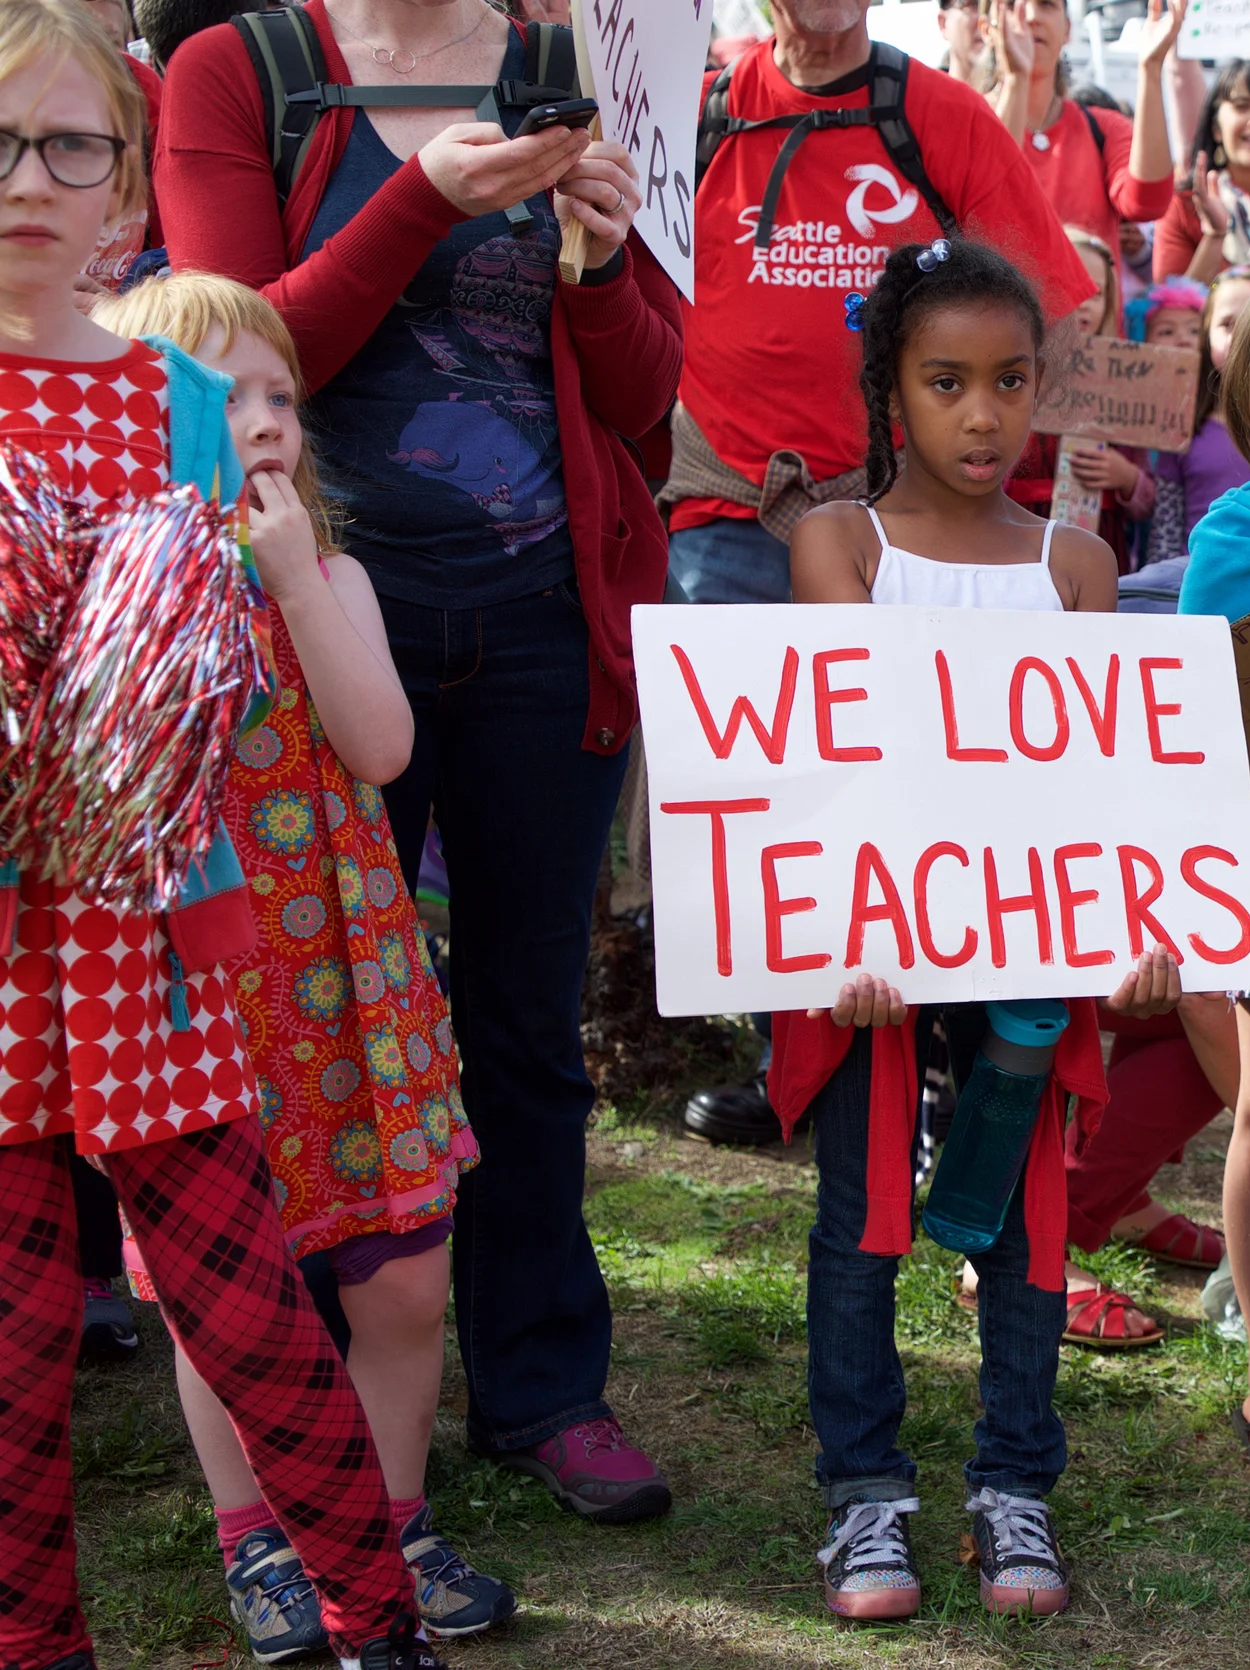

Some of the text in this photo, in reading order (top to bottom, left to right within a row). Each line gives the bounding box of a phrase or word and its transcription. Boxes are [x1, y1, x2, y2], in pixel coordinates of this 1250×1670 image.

[734, 205, 842, 245] Sattle
[752, 241, 890, 265] Education
[669, 643, 1206, 765] WE LOVE
